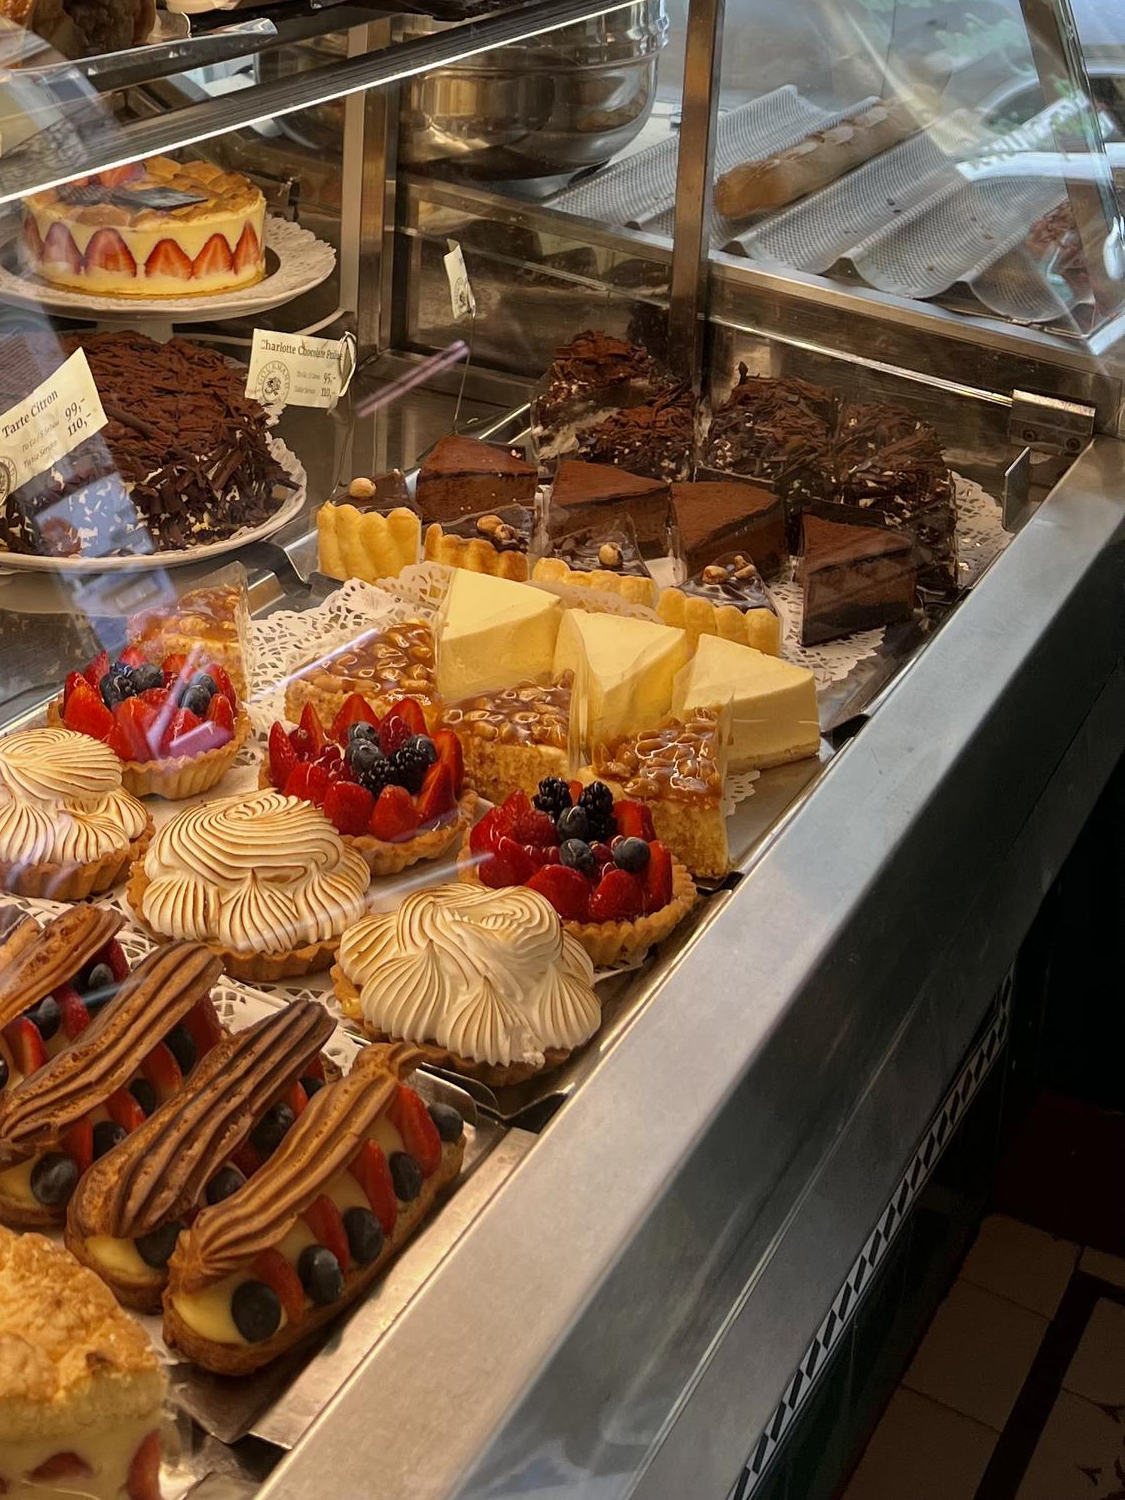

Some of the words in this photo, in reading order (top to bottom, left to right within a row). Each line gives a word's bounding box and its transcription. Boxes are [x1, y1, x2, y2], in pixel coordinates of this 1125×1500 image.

[260, 338, 297, 356] Charlotte
[297, 345, 326, 360] Chocolate
[1, 413, 31, 439] Tarte
[30, 389, 59, 418] Citron
[64, 396, 86, 422] 99,-
[66, 412, 92, 438] 110,-
